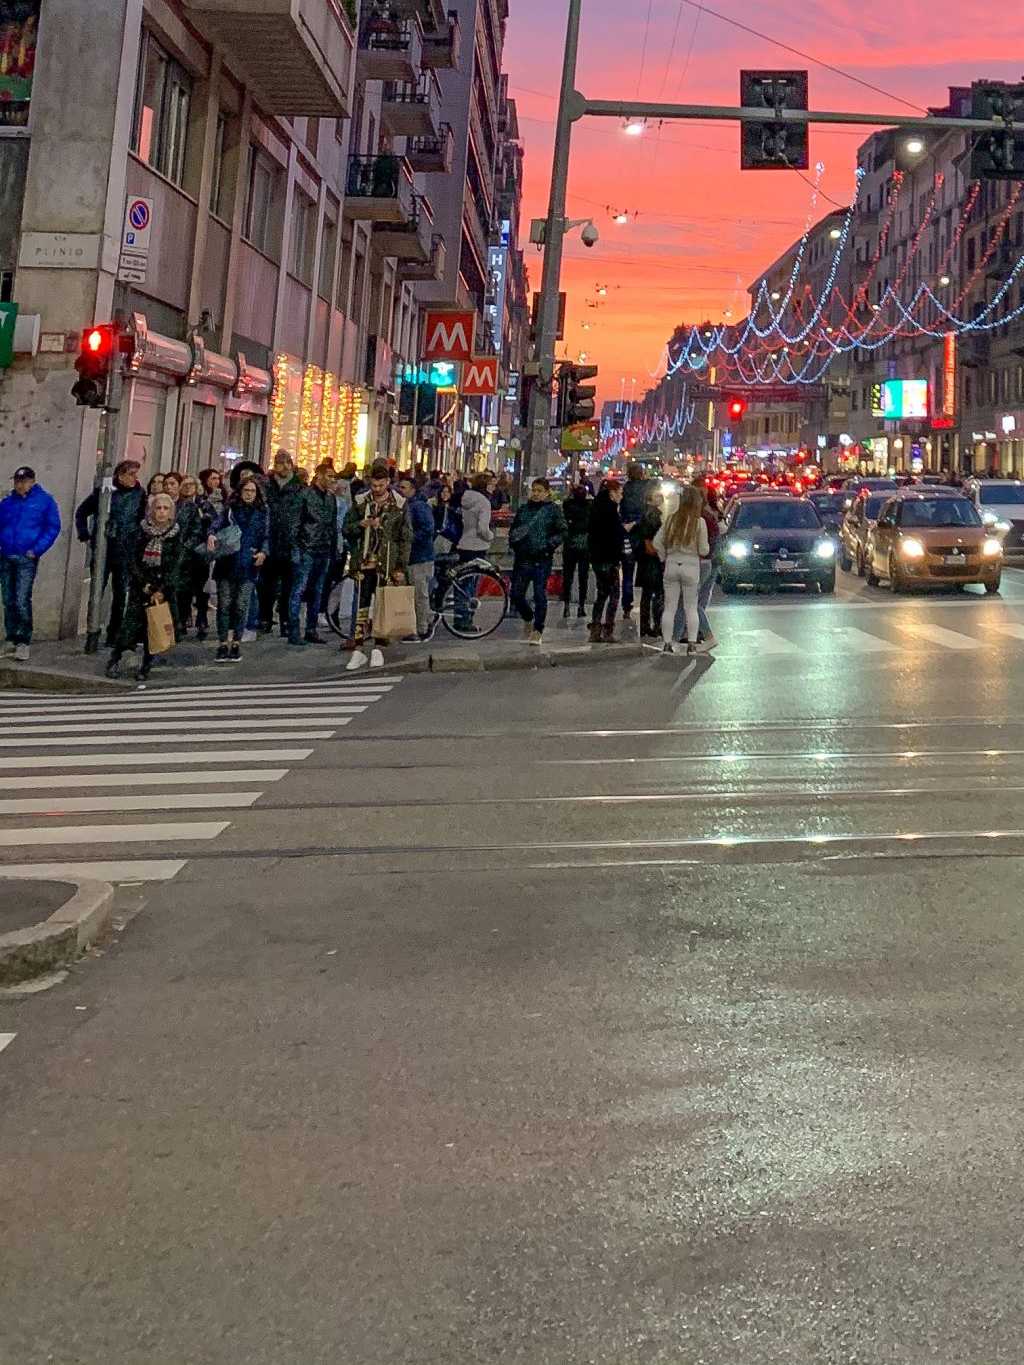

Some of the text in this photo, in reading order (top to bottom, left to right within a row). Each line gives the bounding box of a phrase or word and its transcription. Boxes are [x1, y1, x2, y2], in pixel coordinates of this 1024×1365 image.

[35, 247, 84, 256] PLINIO
[428, 322, 469, 352] M
[464, 365, 494, 387] M
